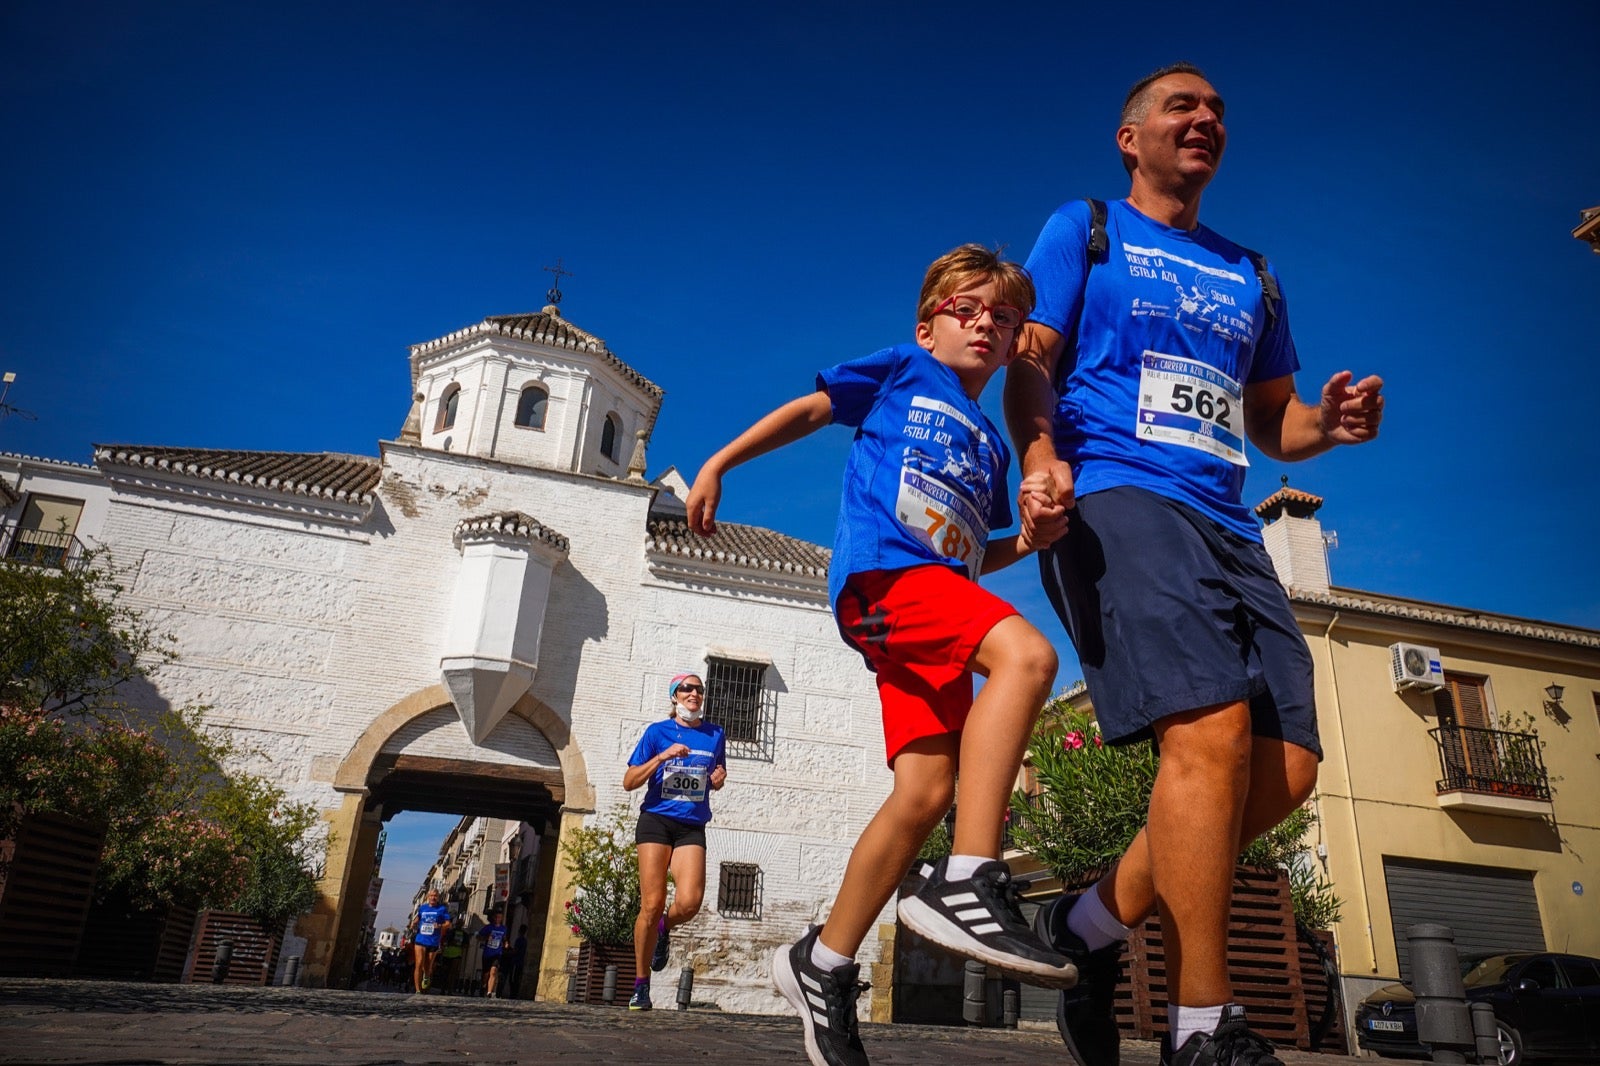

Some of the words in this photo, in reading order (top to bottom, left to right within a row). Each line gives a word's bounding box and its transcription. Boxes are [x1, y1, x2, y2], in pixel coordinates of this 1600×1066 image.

[1125, 253, 1151, 266] VUELVE
[1154, 258, 1165, 268] LA
[1129, 265, 1158, 279] ESTELA
[1162, 272, 1180, 285] AZUL
[1160, 359, 1188, 373] CARRERA
[1190, 365, 1204, 378] AZUL
[1170, 383, 1231, 430] 562
[908, 409, 933, 426] VUELVE
[935, 414, 945, 428] LA
[903, 425, 930, 441] ESTELA
[933, 430, 953, 448] AZUL
[911, 474, 920, 487] VI
[921, 479, 949, 502] CARRERA
[673, 777, 699, 790] 306
